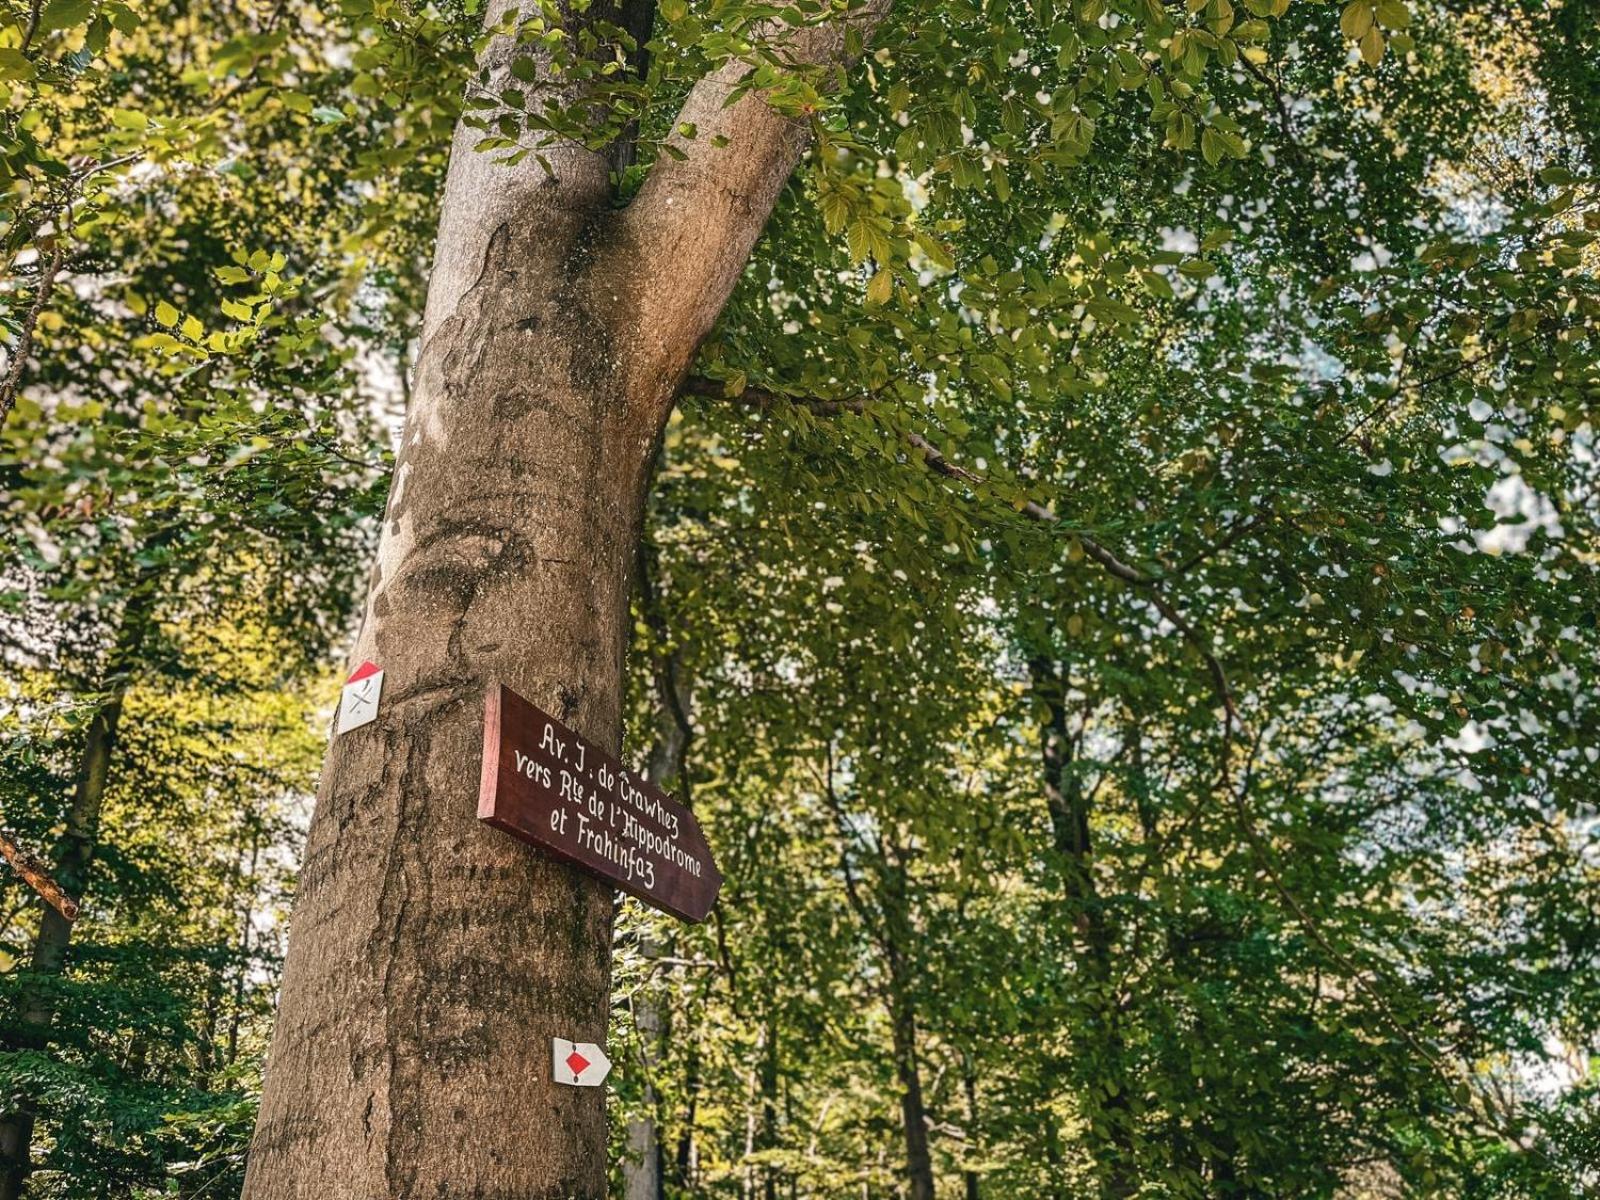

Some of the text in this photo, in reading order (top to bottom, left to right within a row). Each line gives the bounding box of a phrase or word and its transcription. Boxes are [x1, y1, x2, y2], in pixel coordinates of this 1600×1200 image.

[514, 749, 551, 789] vers
[560, 770, 584, 804] Rte
[588, 792, 605, 821] de
[539, 723, 568, 763] Av.
[598, 763, 614, 791] de
[620, 776, 680, 839] Crawhez
[550, 808, 655, 889] et Frahinfaz
